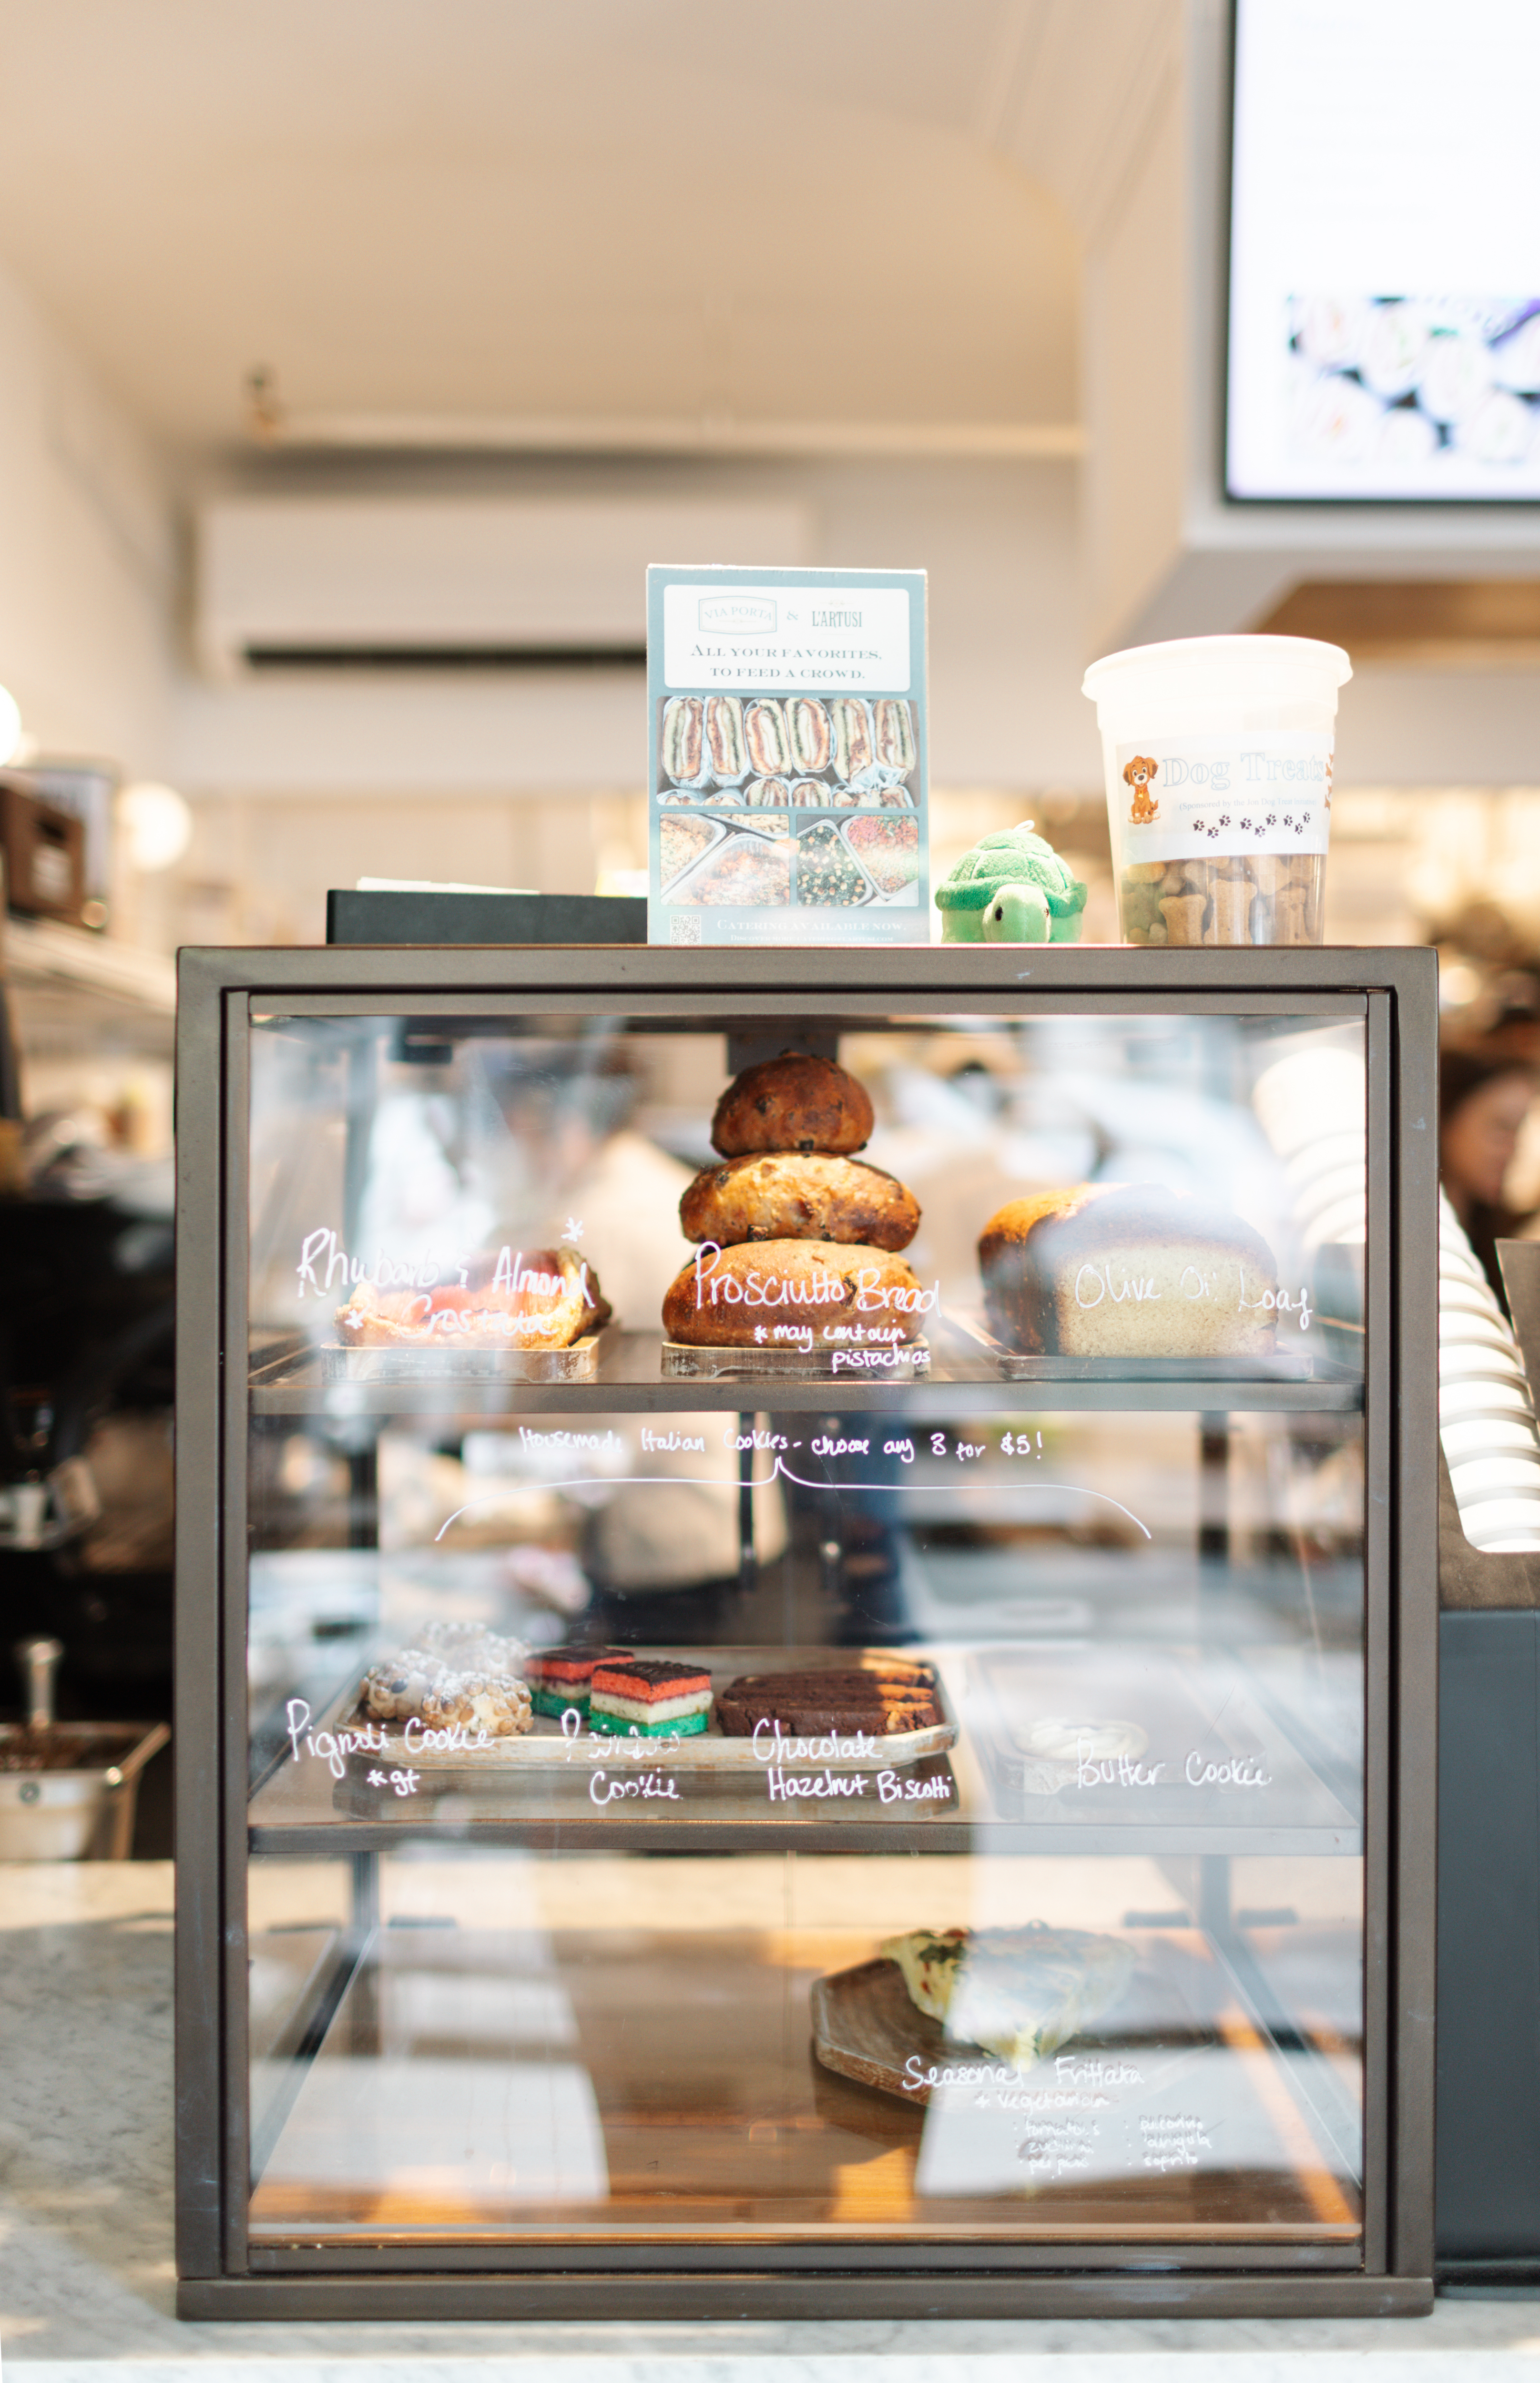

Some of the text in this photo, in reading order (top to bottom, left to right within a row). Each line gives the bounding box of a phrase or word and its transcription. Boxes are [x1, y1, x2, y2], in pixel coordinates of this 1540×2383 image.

[704, 606, 863, 628] VIA PORTA & L'ARTUSI
[690, 644, 883, 661] ALL YOUR FAVORITES,
[710, 668, 866, 679] TO FEED A CROWD.
[1163, 752, 1325, 791] Dog Treats
[1179, 800, 1220, 811] (Sponsored
[1222, 799, 1232, 808] by
[1261, 798, 1275, 807] Dog
[1294, 797, 1317, 806] Initiative)
[717, 919, 787, 930] CATERING
[791, 922, 869, 930] AVAILABLE
[296, 1227, 440, 1298] Rhubarb
[492, 1245, 595, 1308] Almond
[694, 1241, 942, 1317] Prosciutto Bread
[1075, 1264, 1162, 1308] Olive
[398, 1294, 557, 1339] Crostata
[823, 1318, 907, 1343] contain
[832, 1342, 931, 1374] pistachios
[519, 1426, 622, 1453] Housemade
[641, 1427, 705, 1452] Italian
[811, 1435, 869, 1456] choose
[883, 1438, 914, 1463] any
[930, 1433, 947, 1455] 3
[287, 1698, 495, 1779] Pignoli Cookie
[753, 1717, 883, 1763] Chocolate
[1077, 1737, 1272, 1789] Butter Cookie
[590, 1767, 683, 1805] Cookie
[768, 1766, 952, 1803] Hazelnut Biscotti
[902, 2055, 1145, 2090] Seasonal Frittata
